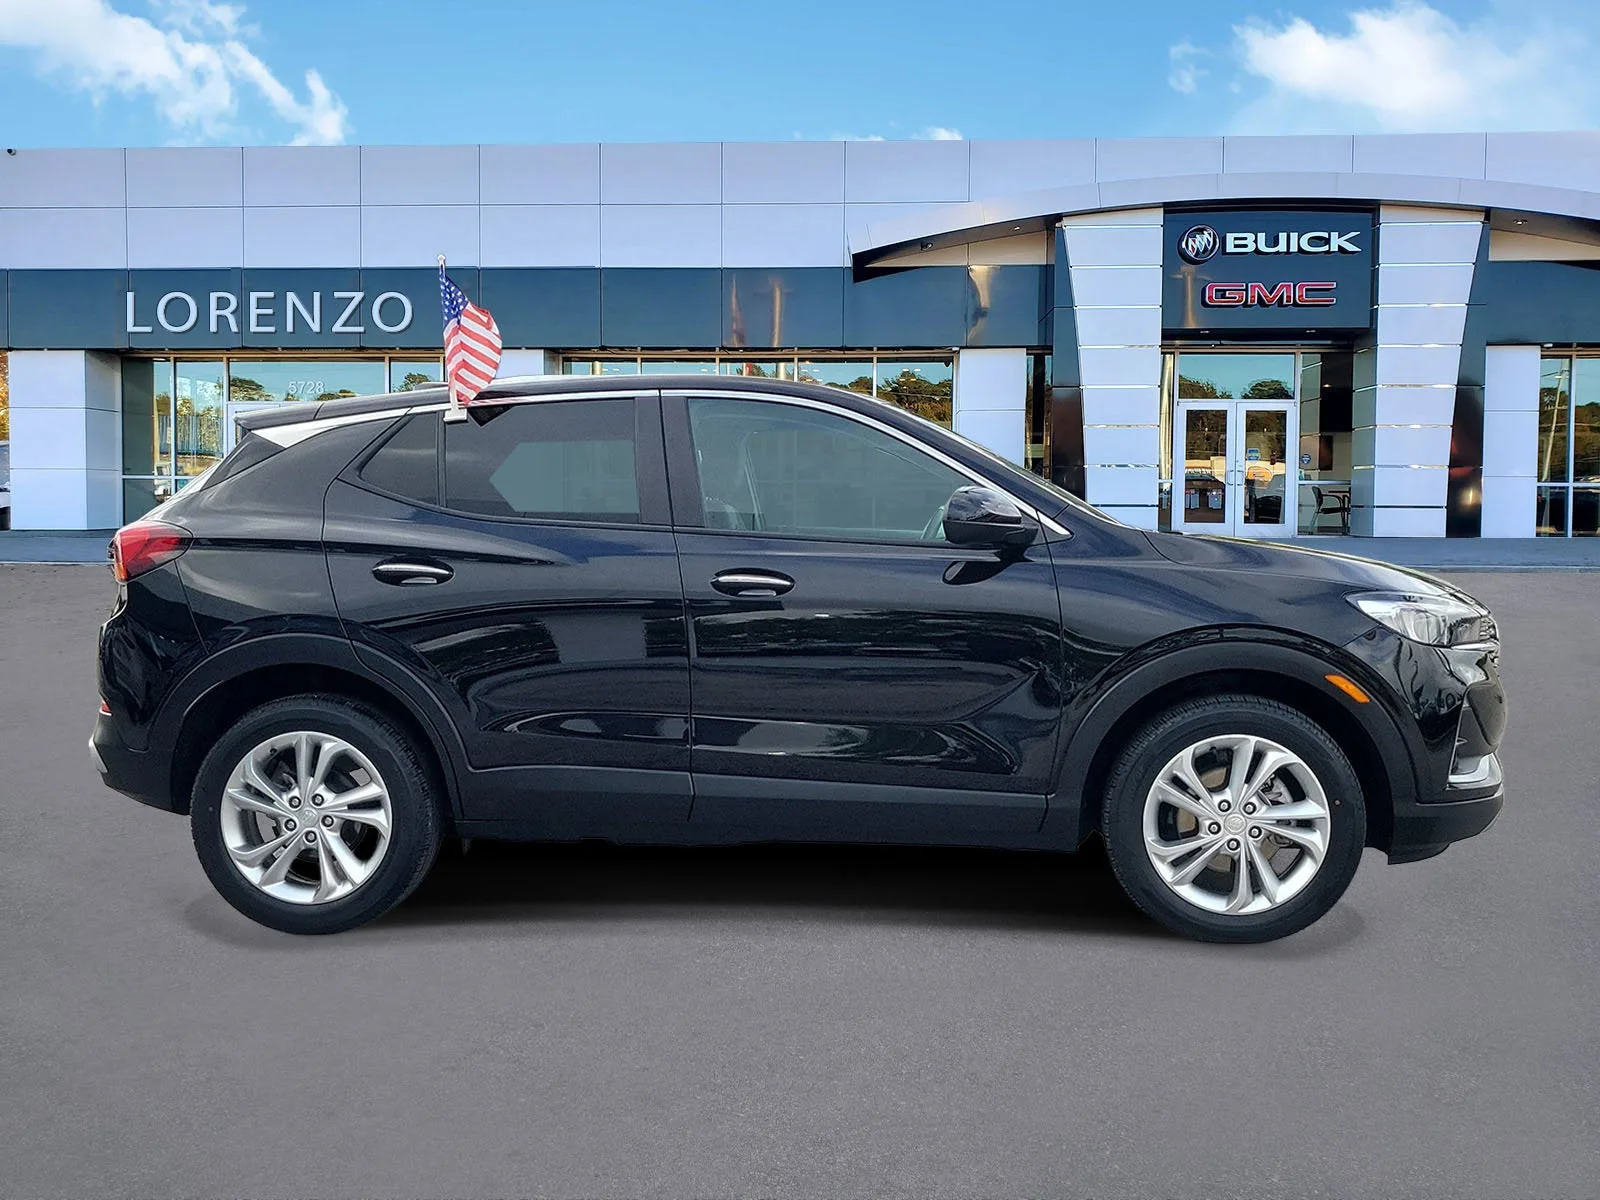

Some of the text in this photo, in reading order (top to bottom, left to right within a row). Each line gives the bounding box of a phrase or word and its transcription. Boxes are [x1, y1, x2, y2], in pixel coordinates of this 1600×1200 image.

[1226, 231, 1362, 253] BUICK
[1205, 281, 1337, 305] GMC
[126, 291, 413, 333] LORENZO
[288, 381, 325, 394] 5728
